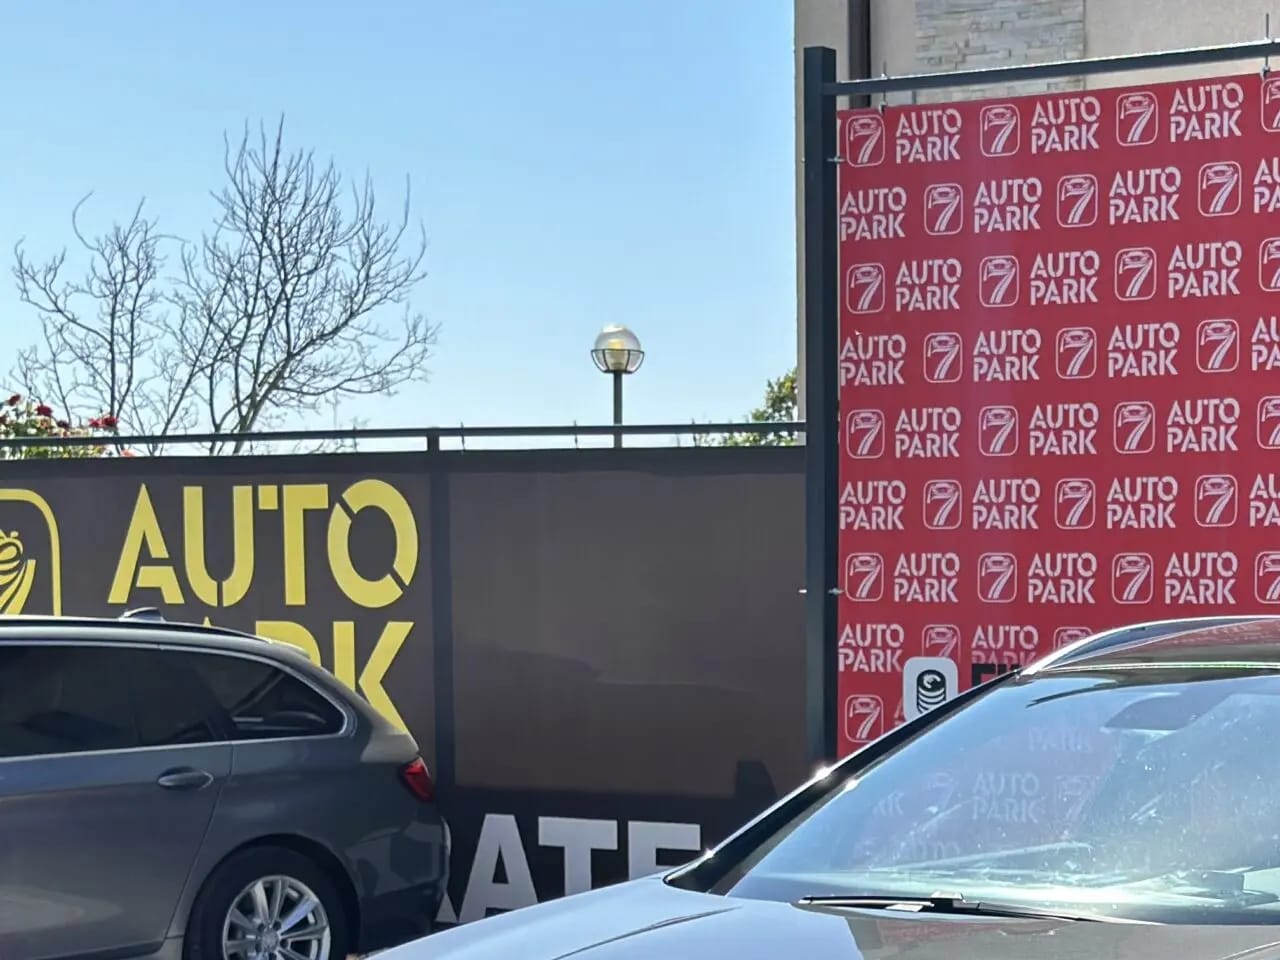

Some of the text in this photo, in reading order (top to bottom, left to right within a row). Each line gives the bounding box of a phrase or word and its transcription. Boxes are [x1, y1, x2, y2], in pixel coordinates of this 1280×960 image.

[1031, 96, 1100, 126] AUTO
[1171, 82, 1243, 114] AUTO
[896, 107, 961, 137] AUTO
[1170, 109, 1241, 142] PARK
[896, 135, 960, 163] PARK
[1032, 123, 1099, 154] PARK
[973, 177, 1042, 207] AUTO
[1109, 166, 1181, 197] AUTO
[838, 183, 906, 216] AUTO
[1109, 194, 1179, 225] PARK
[838, 213, 905, 243] PARK
[974, 204, 1040, 233] PARK
[1030, 250, 1100, 278] AUTO
[1168, 240, 1242, 271] AUTO
[895, 258, 961, 285] AUTO
[1168, 268, 1240, 298] PARK
[896, 284, 960, 312] PARK
[1031, 277, 1098, 305] PARK
[838, 331, 906, 362] AUTO
[973, 328, 1041, 355] AUTO
[1107, 322, 1180, 350] AUTO
[838, 360, 904, 388] PARK
[973, 355, 1039, 382] PARK
[1108, 349, 1178, 377] PARK
[895, 406, 961, 432] AUTO
[1029, 402, 1099, 429] AUTO
[1167, 397, 1240, 425] AUTO
[895, 432, 959, 458] PARK
[1030, 429, 1097, 456] PARK
[1167, 425, 1238, 452] PARK
[839, 480, 906, 504] AUTO
[972, 478, 1040, 503] AUTO
[1107, 476, 1178, 502] AUTO
[840, 505, 904, 530] PARK
[973, 504, 1038, 530] PARK
[1107, 502, 1176, 529] PARK
[107, 479, 418, 608] AUTO
[894, 552, 960, 577] AUTO
[1028, 552, 1097, 577] AUTO
[1165, 551, 1238, 577] AUTO
[894, 578, 958, 602] PARK
[1028, 578, 1095, 603] PARK
[1165, 579, 1235, 604] PARK
[838, 624, 904, 647] AUTO
[972, 625, 1038, 649] AUTO
[838, 648, 904, 675] PARK
[436, 813, 700, 923] ATE
